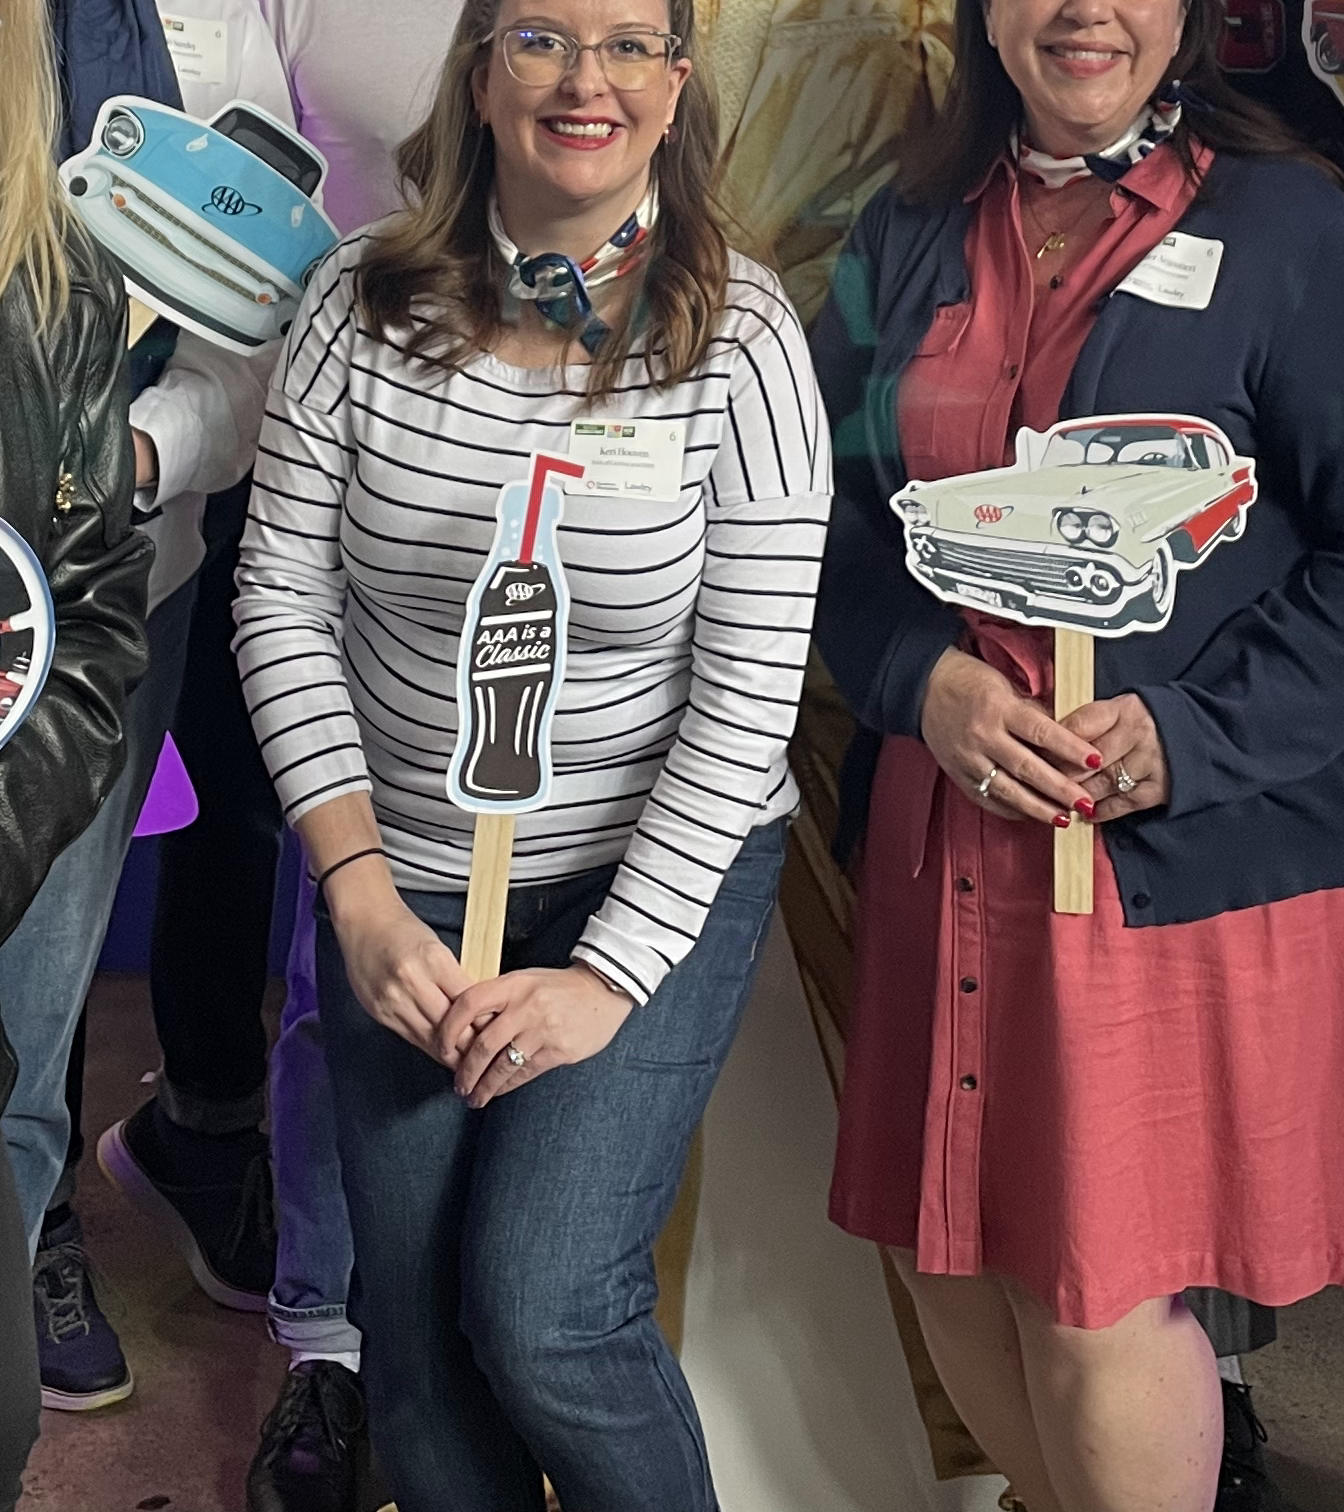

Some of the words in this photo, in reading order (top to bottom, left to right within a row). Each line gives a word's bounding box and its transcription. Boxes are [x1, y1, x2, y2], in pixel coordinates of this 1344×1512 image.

[211, 186, 245, 216] AAA
[476, 629, 518, 646] AAA
[522, 623, 538, 641] is
[539, 625, 552, 640] a
[475, 640, 551, 669] Classic
